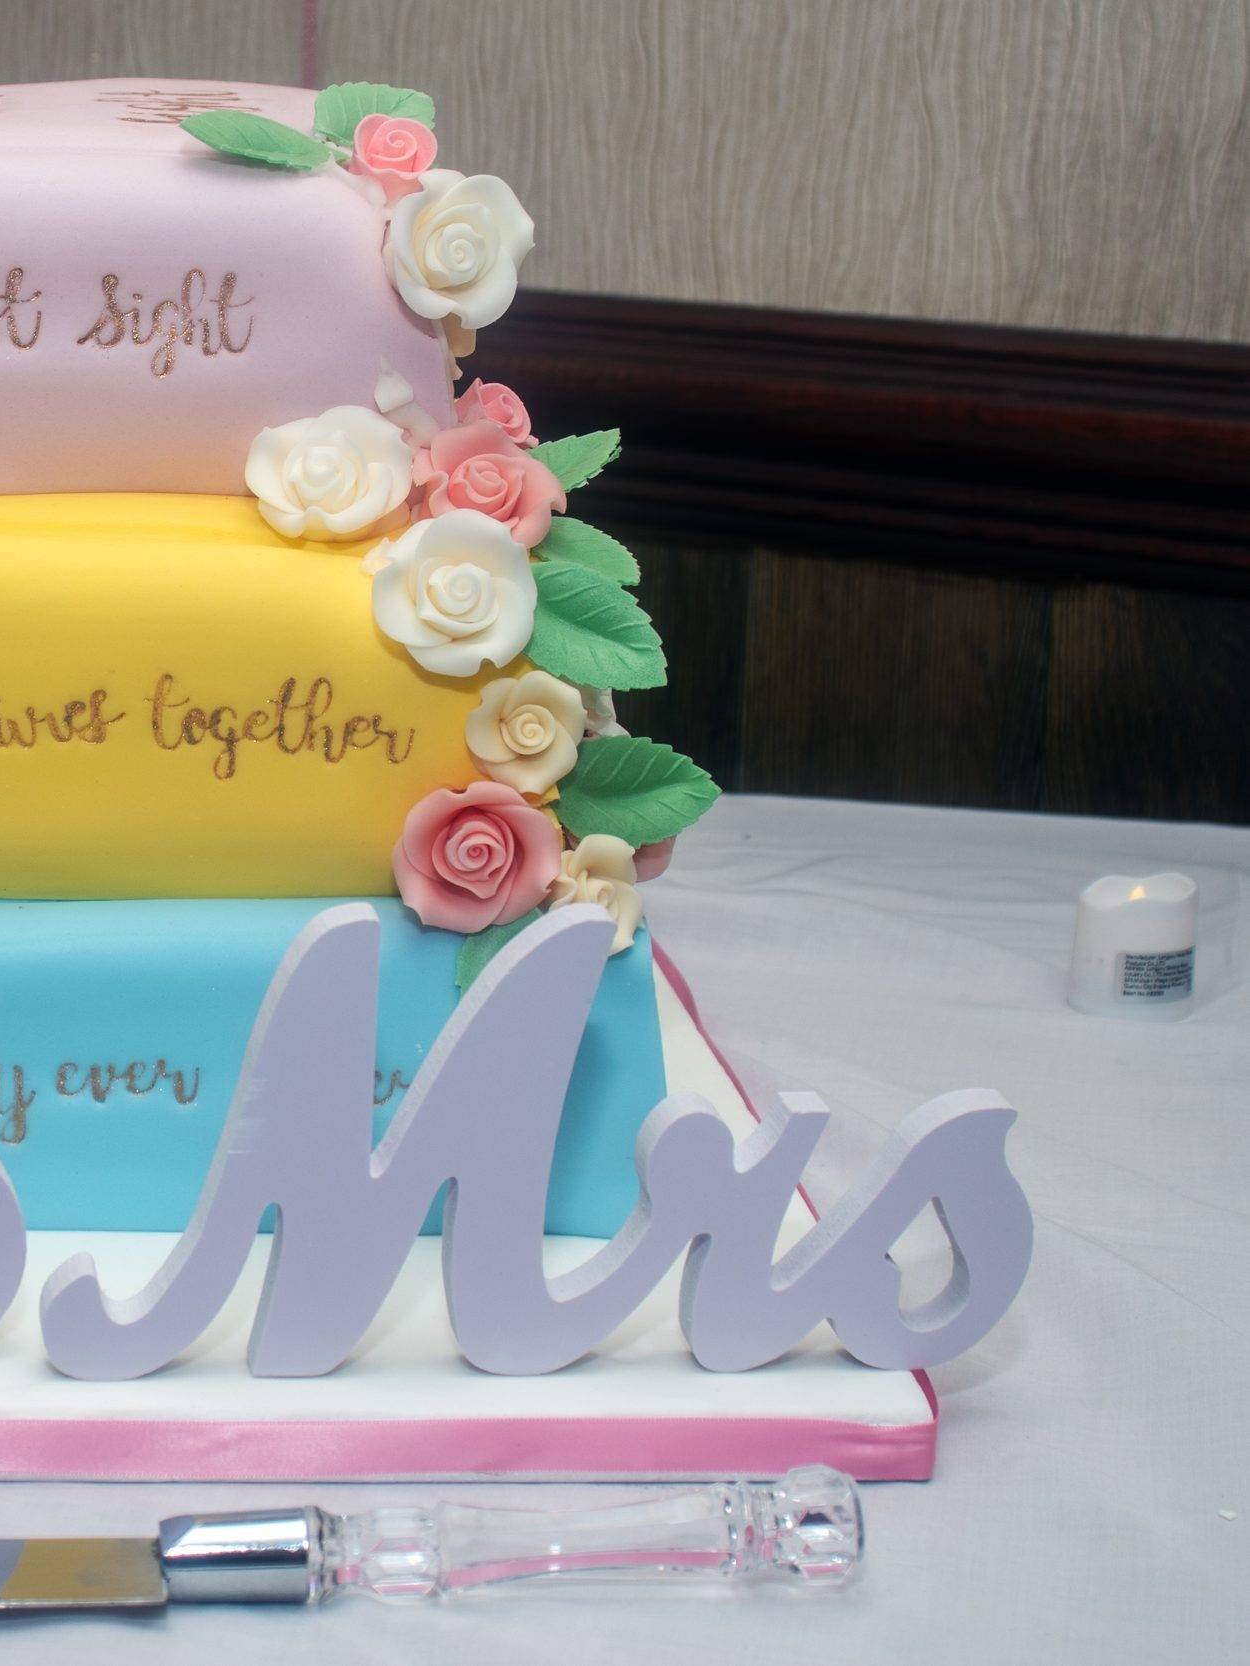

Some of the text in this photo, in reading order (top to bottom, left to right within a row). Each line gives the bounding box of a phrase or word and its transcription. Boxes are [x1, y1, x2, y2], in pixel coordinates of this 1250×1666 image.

[75, 268, 256, 378] Sight
[144, 673, 415, 780] together
[56, 1059, 200, 1105] ever
[40, 900, 1034, 1379] Mrs
